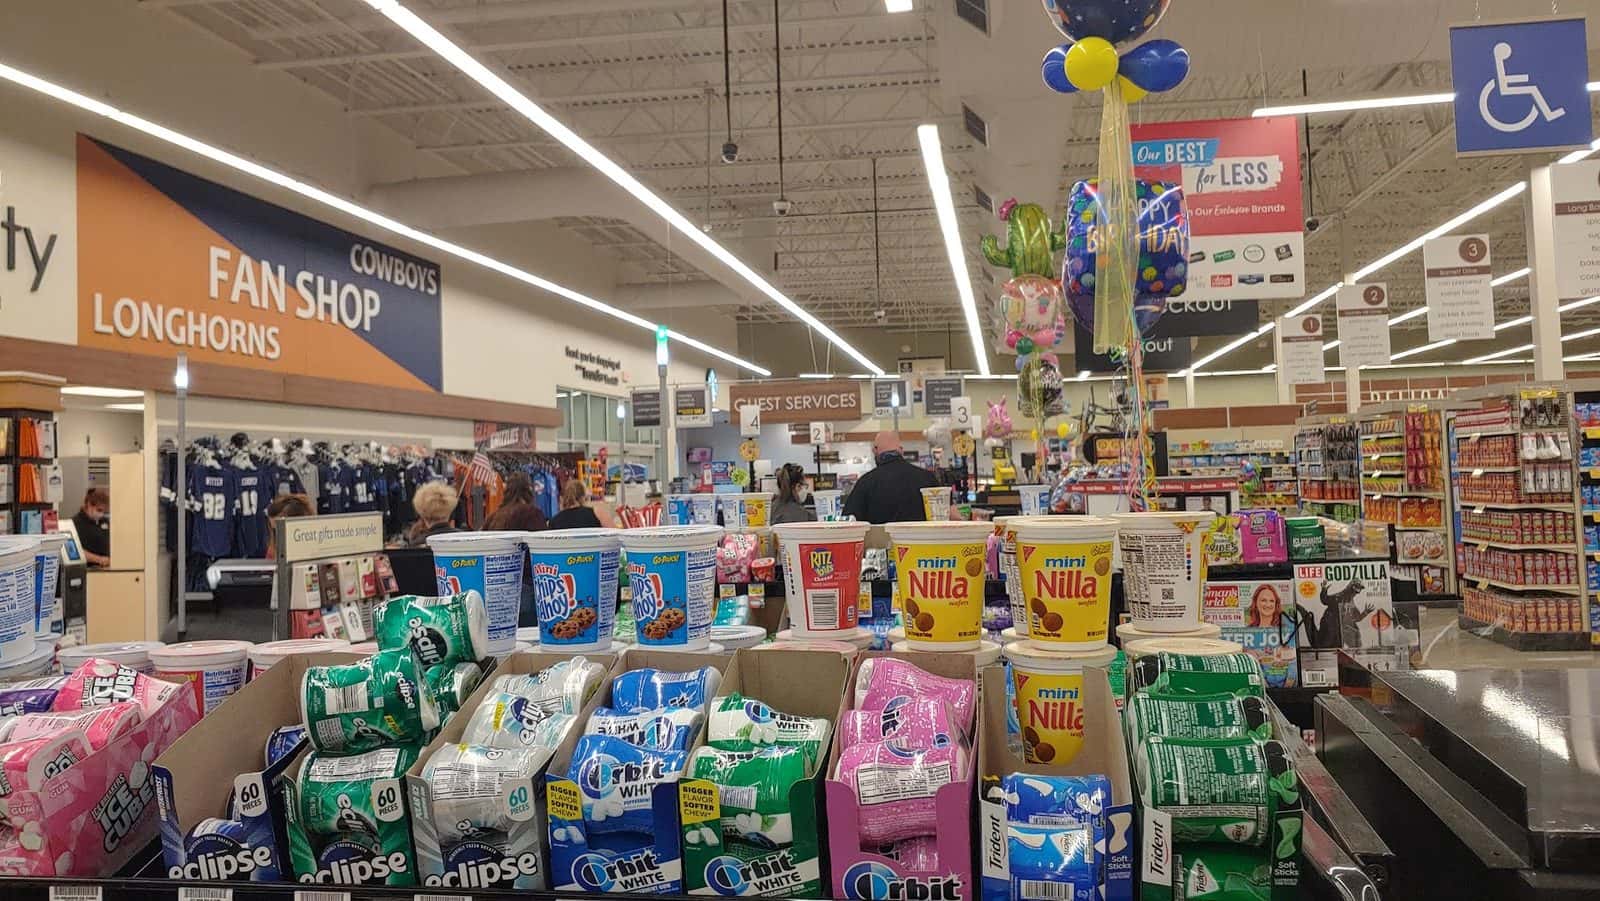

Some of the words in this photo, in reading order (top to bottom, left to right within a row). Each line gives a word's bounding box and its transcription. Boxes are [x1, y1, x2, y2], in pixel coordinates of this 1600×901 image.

[1137, 146, 1160, 163] Our
[1165, 141, 1207, 163] BEST
[1197, 167, 1216, 193] for
[1220, 161, 1269, 187] LESS
[1195, 207, 1213, 217] Our
[1214, 203, 1250, 217] Exclusive
[1251, 203, 1286, 214] Brands
[1468, 243, 1478, 257] 3
[351, 243, 438, 296] COWBOYS
[209, 245, 286, 312] FAN
[295, 270, 381, 332] SHOP
[1370, 290, 1378, 301] 2
[94, 293, 280, 359] LONGHORNS
[785, 393, 857, 411] SERVICES
[750, 415, 760, 429] 4
[958, 406, 969, 424] 3
[813, 427, 822, 441] 2
[203, 493, 226, 520] 82
[293, 527, 317, 542] Great
[318, 525, 334, 544] gifts
[334, 524, 355, 539] made
[355, 522, 377, 537] simple
[810, 550, 833, 569] RITZ
[917, 556, 957, 569] mini
[1045, 555, 1086, 568] mini
[1299, 566, 1321, 578] LIFE
[1325, 564, 1387, 581] GODZILLA
[535, 577, 565, 598] hips
[908, 570, 969, 599] Nilla
[1034, 569, 1097, 599] Nilla
[1207, 587, 1238, 598] man's
[409, 617, 442, 663] lipse
[1038, 687, 1079, 700] mini
[519, 700, 547, 745] ecli
[578, 753, 665, 801] Orbit
[50, 781, 70, 798] GUM
[241, 782, 259, 803] 60
[377, 787, 396, 807] 60
[508, 786, 528, 807] 60
[550, 785, 577, 797] BIGGER
[550, 792, 578, 804] FLAVOR
[619, 783, 656, 799] WHIT
[683, 786, 713, 796] BIGGER
[683, 794, 713, 804] FLAVOR
[10, 804, 35, 816] GUM
[100, 783, 133, 831] ICE
[242, 798, 262, 811] PIECES
[378, 802, 399, 816] PIECES
[510, 802, 530, 816] PIECES
[551, 800, 578, 811] SOFTER
[684, 802, 714, 811] SOFTER
[989, 816, 1003, 869] Trident
[1150, 821, 1165, 876] Trident
[168, 846, 272, 880] eclipse
[299, 851, 407, 885] eclipse
[1112, 855, 1128, 863] Soft
[1278, 861, 1296, 869] Soft
[425, 852, 537, 888] eclipse
[571, 852, 660, 893] Orbit
[704, 852, 797, 896] Orbit
[1274, 868, 1299, 876] Sticks
[619, 871, 665, 890] WHITE
[754, 871, 802, 892] WHITE
[842, 861, 962, 901] Orbit
